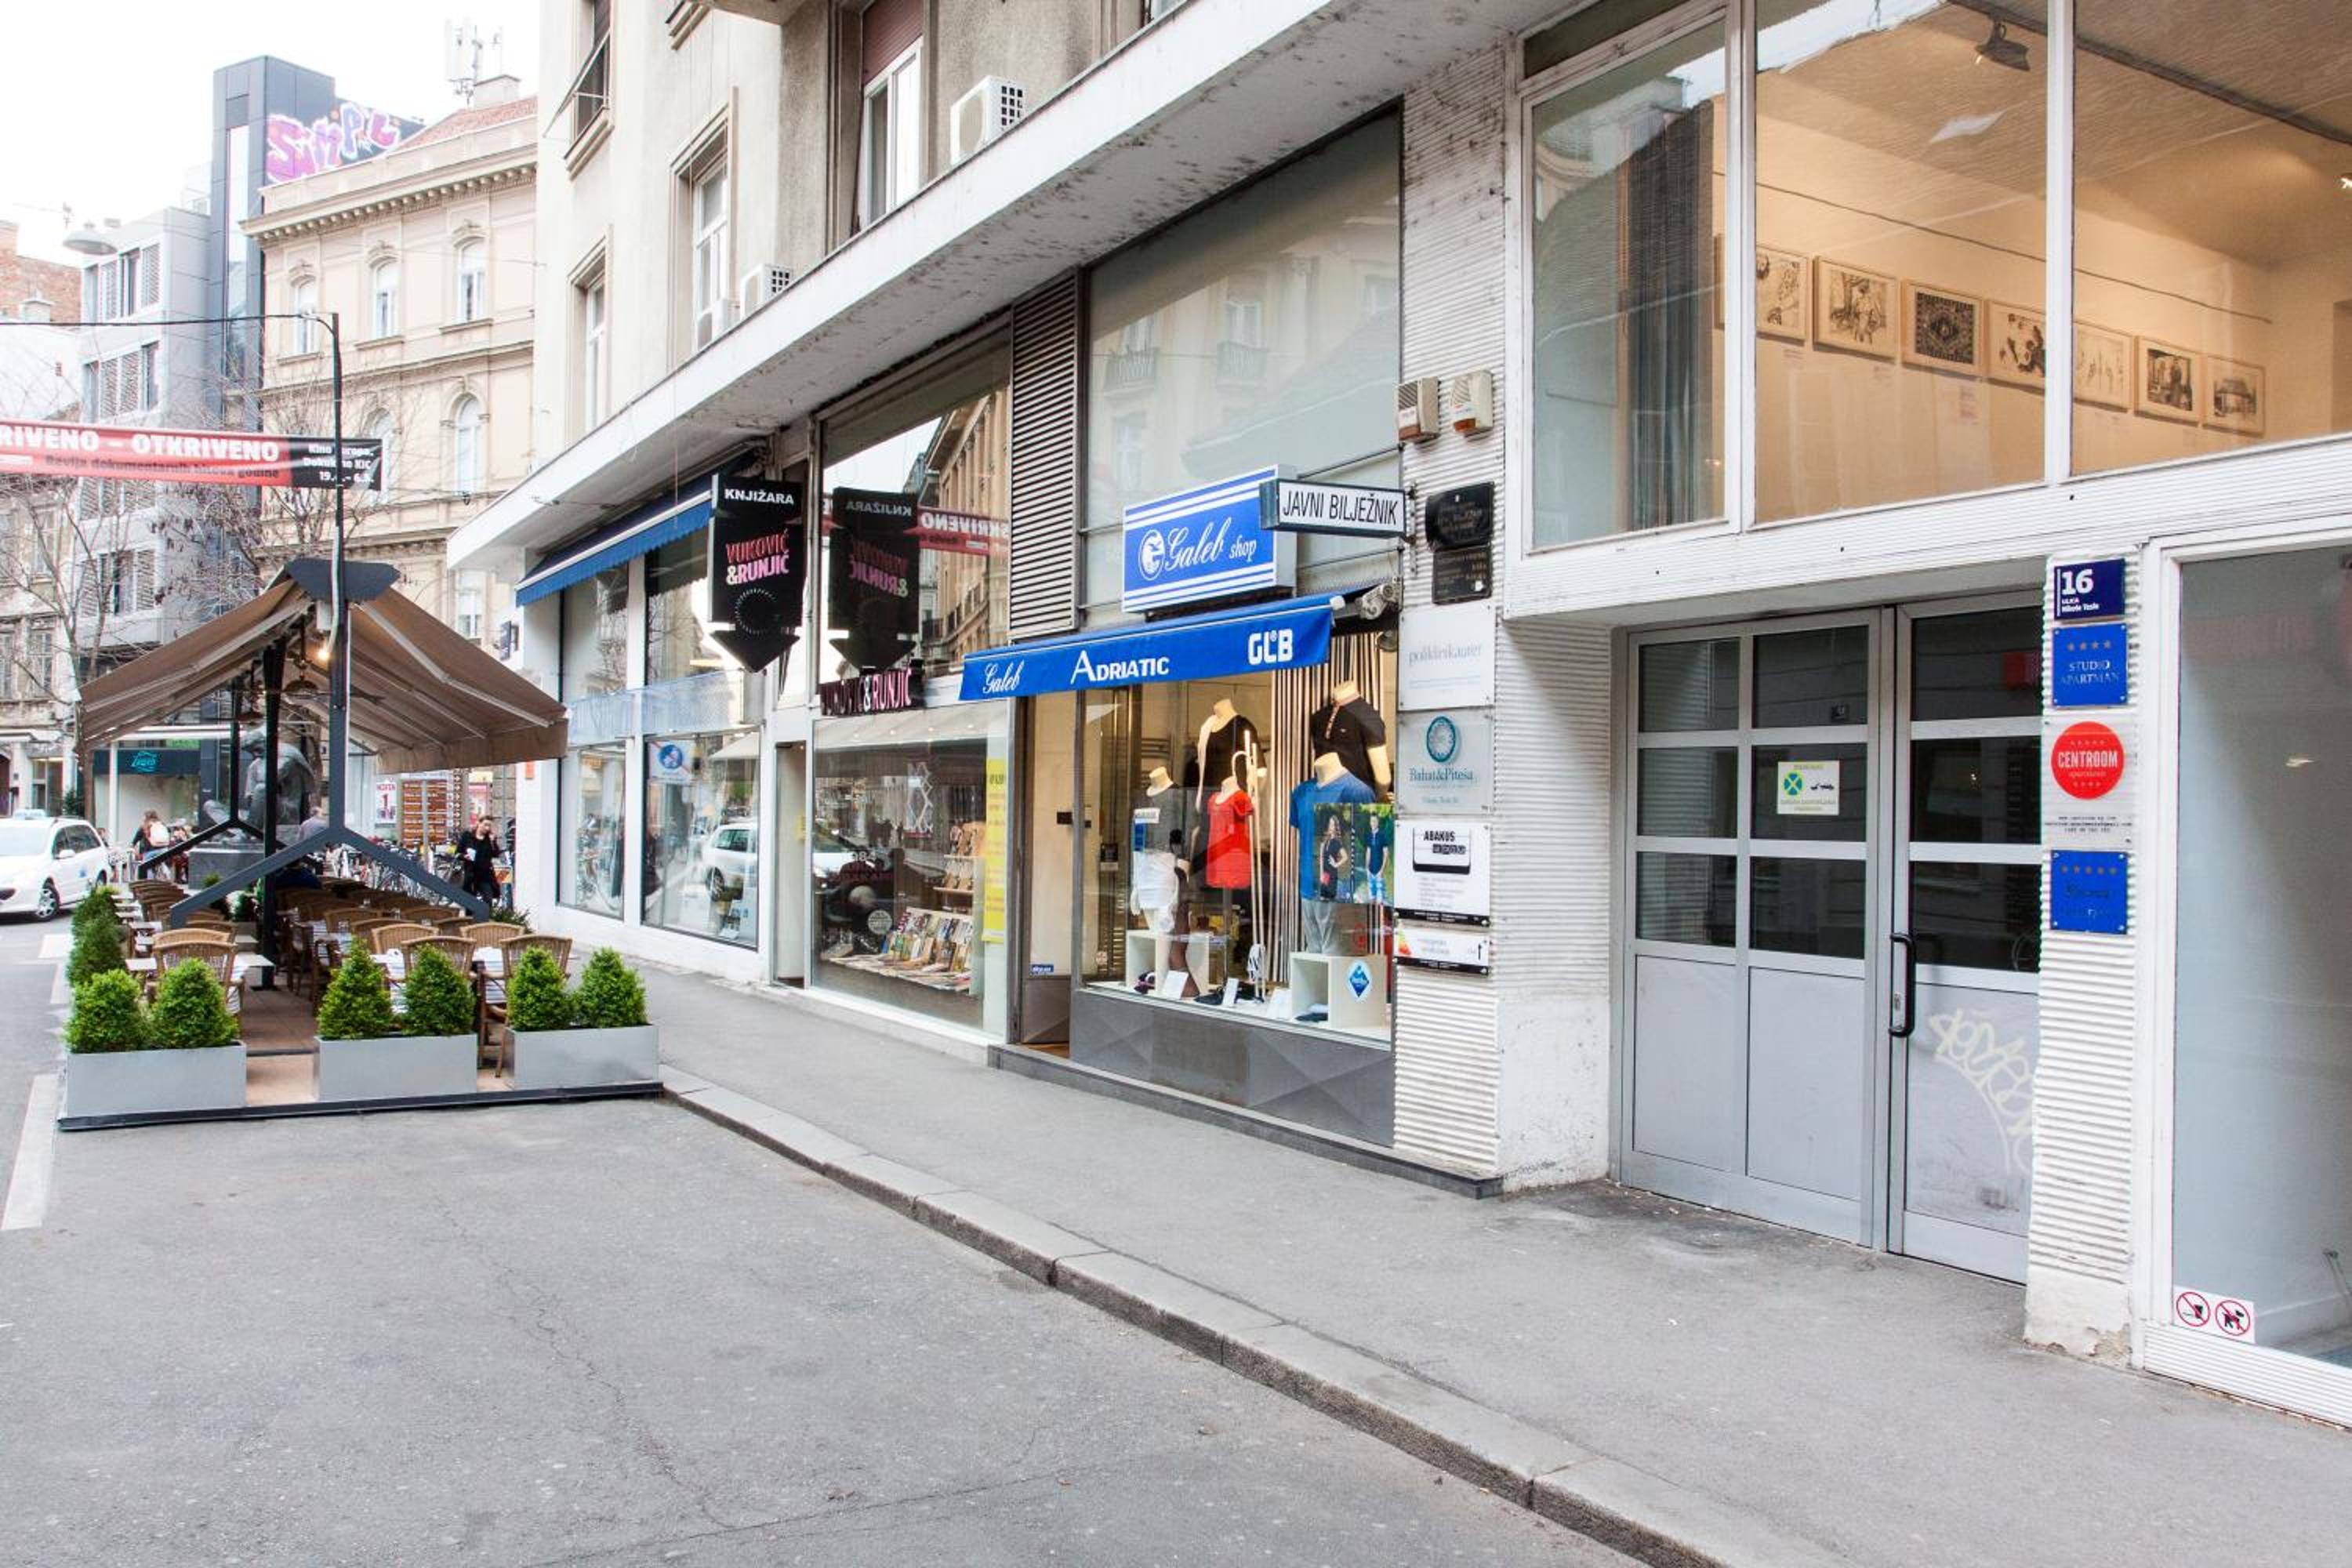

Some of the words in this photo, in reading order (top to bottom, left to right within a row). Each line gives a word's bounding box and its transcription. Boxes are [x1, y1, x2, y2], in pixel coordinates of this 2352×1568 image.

[132, 434, 280, 461] OTKRIVENO
[724, 488, 794, 505] KNJIŽARA
[1283, 489, 1324, 517] JAVNI
[1329, 493, 1398, 526] BILJEŽNIK
[726, 528, 789, 564] VUKOVIĆ
[1163, 517, 1232, 572] Galeb
[1229, 534, 1257, 562] shop
[726, 549, 789, 585] &RUNJIĆ
[2062, 568, 2094, 595] 16
[982, 659, 1025, 695] Galeb
[2060, 672, 2120, 685] APARTMAN
[2069, 659, 2111, 672] STUDIO
[2057, 750, 2118, 768] CENTROOM
[1424, 830, 1456, 843] ABAKUS
